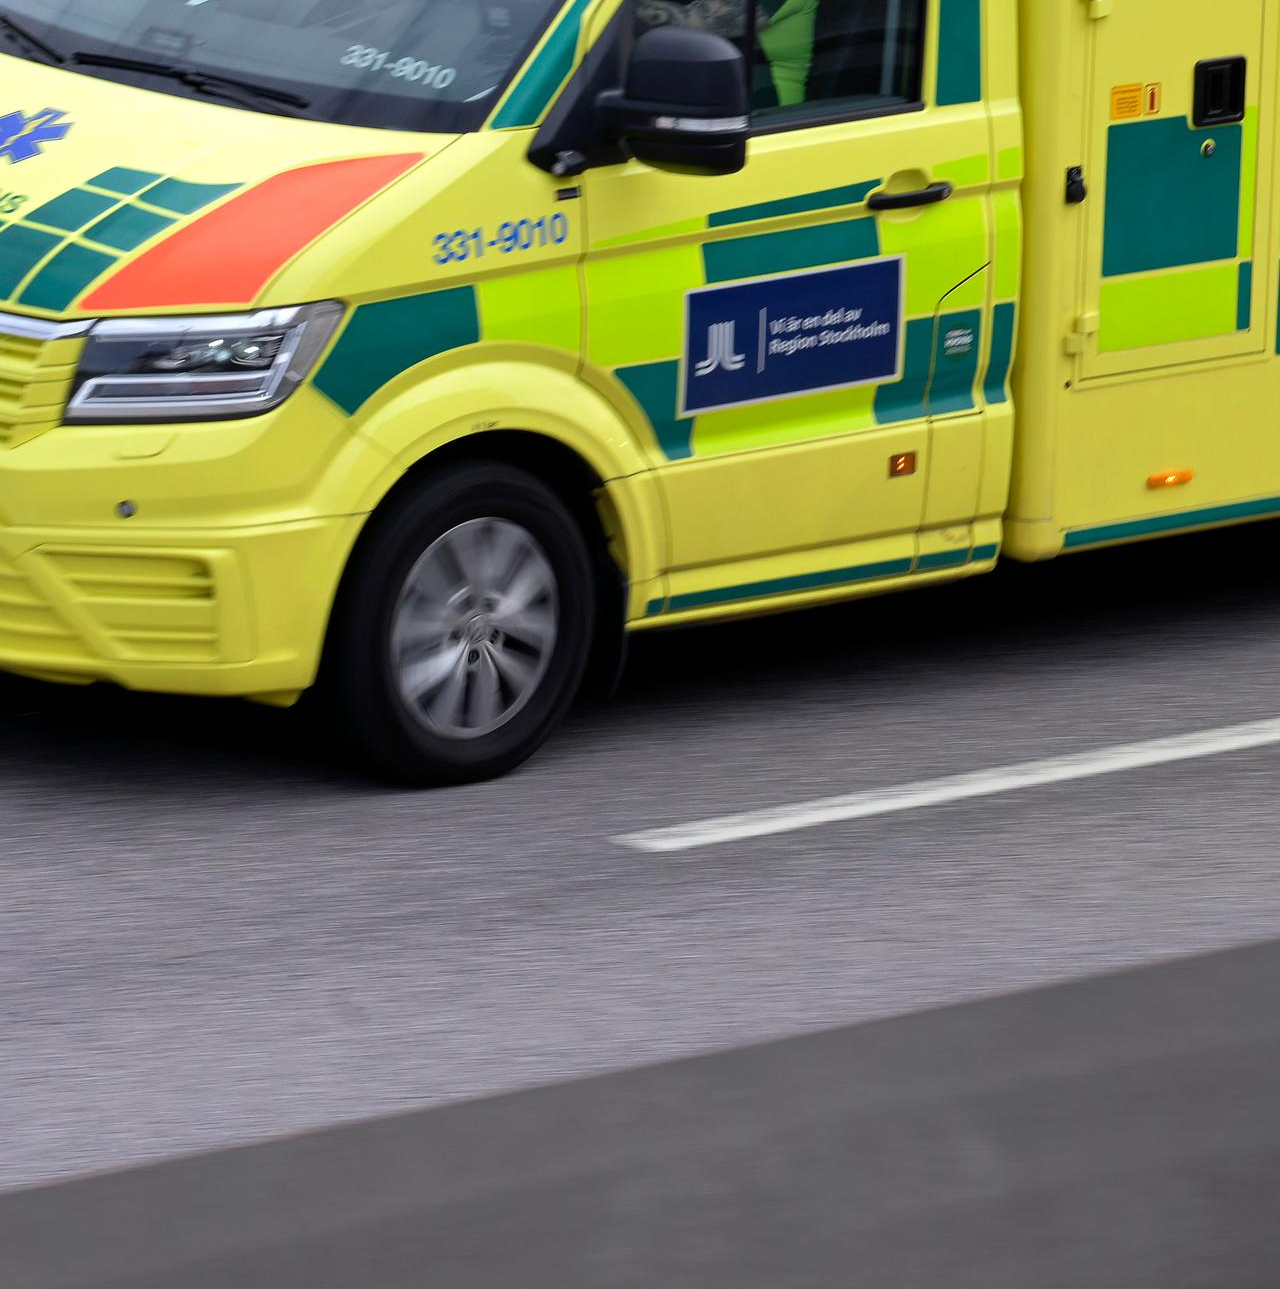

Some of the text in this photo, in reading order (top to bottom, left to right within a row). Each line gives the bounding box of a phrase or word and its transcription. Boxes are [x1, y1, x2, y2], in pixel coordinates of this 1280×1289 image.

[339, 43, 458, 90] 331-9010
[431, 211, 570, 265] 331-9010
[768, 320, 890, 356] Region Stockholm
